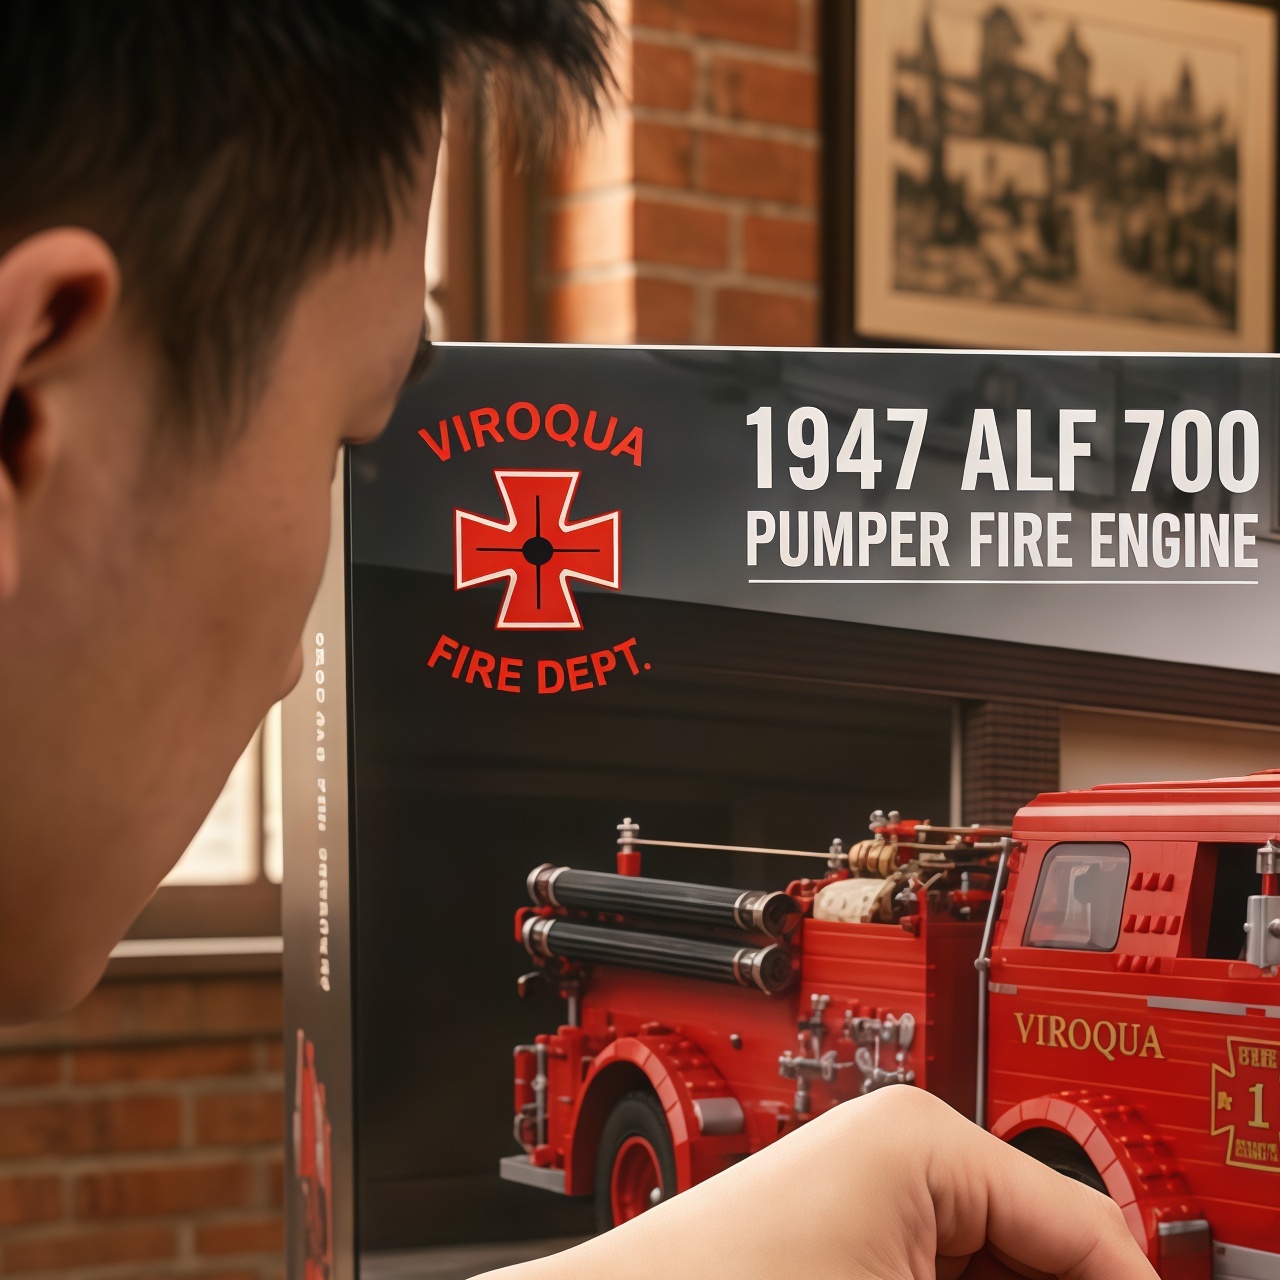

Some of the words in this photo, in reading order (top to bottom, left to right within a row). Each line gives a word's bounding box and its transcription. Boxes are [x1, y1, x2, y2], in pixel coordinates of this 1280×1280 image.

[418, 401, 644, 467] VIROQUA
[746, 406, 929, 491] 1947
[960, 408, 1097, 491] ALF
[1124, 409, 1260, 493] 700
[746, 510, 951, 567] PUMPER
[970, 511, 1073, 567] FIRE
[1091, 512, 1259, 568] ENGINE
[427, 634, 523, 693] FIRE
[537, 637, 651, 694] DEPT.
[1014, 1012, 1166, 1061] VIROQUA
[1248, 1083, 1270, 1129] 1
